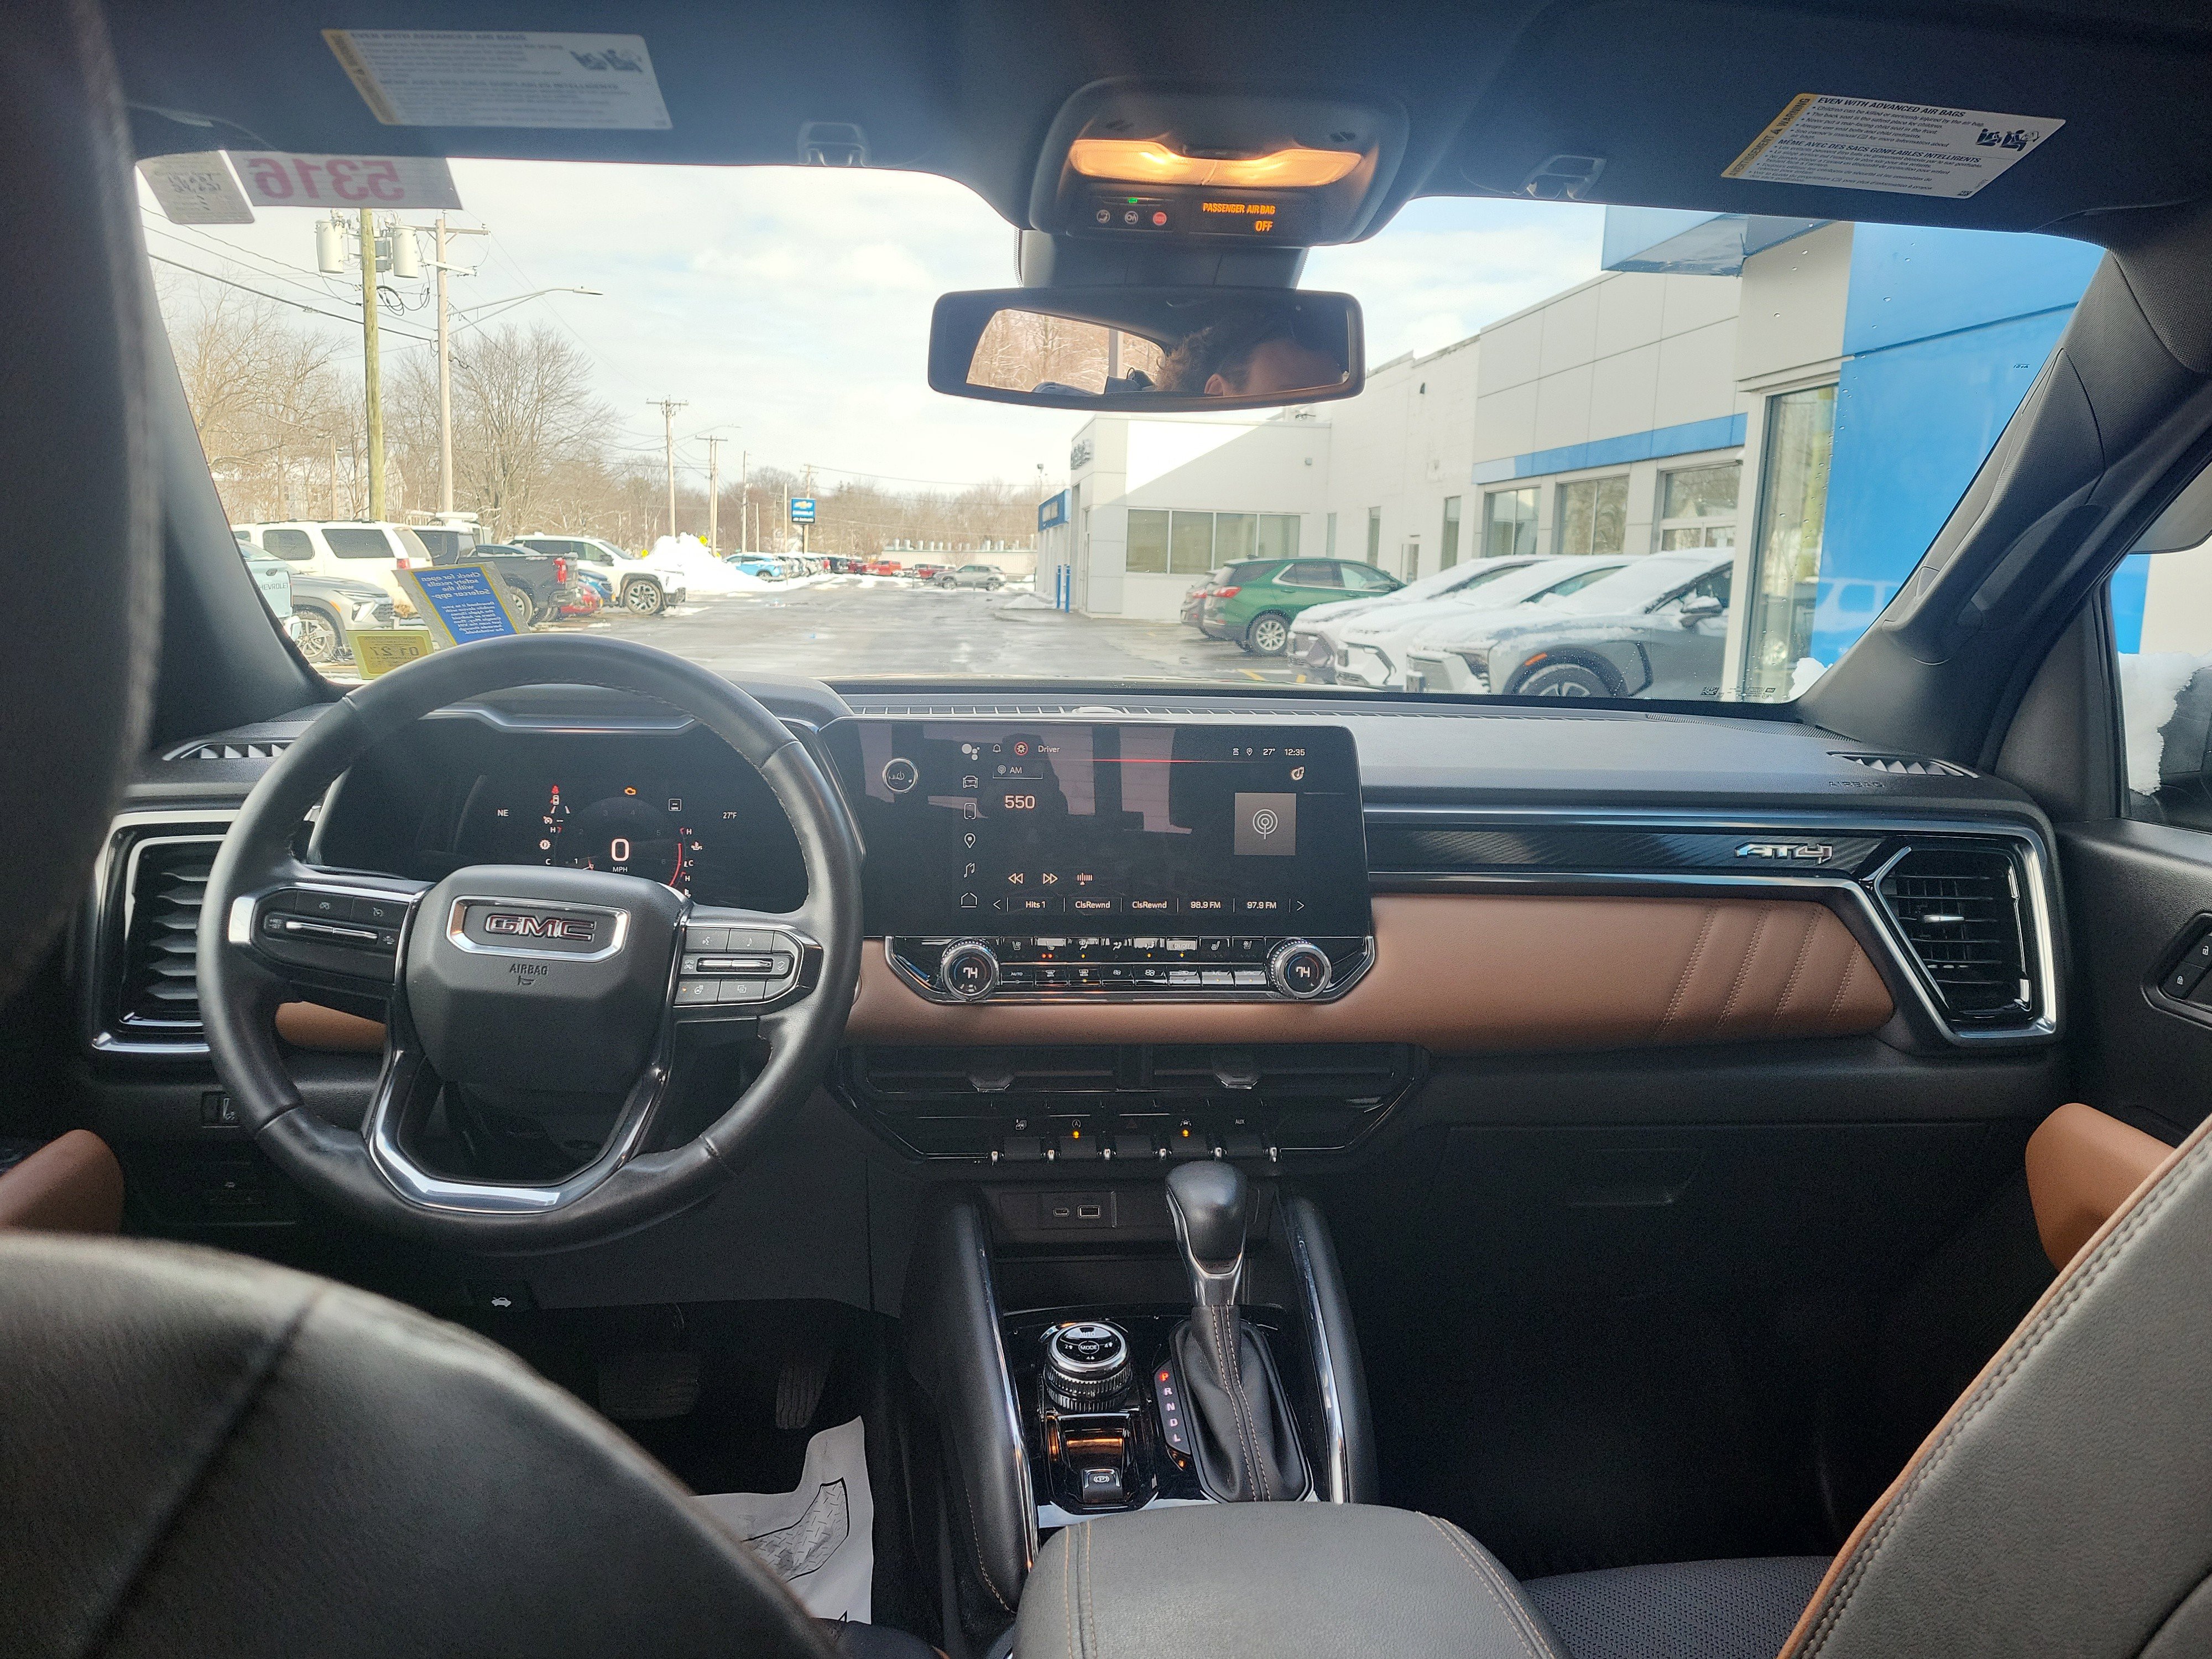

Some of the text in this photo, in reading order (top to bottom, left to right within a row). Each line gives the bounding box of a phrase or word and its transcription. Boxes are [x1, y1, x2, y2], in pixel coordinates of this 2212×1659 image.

[1779, 98, 1811, 127] WARNING
[1869, 102, 1921, 112] ADVANCED
[1871, 148, 1924, 157] GONFLABLES
[1923, 153, 1981, 163] INTELLIGENTS
[1202, 202, 1276, 215] PASSENGER AIR BAG
[1255, 220, 1274, 232] OFF
[1004, 795, 1036, 809] 550
[611, 838, 630, 862] 0
[1735, 842, 1833, 866] AT4
[486, 914, 596, 941] GMC
[508, 963, 549, 975] AIRBAG
[963, 967, 978, 979] 74
[1296, 966, 1311, 978] 74
[1161, 1373, 1168, 1381] P
[1164, 1387, 1172, 1396] R
[1166, 1402, 1175, 1411] N
[1170, 1418, 1178, 1427] D
[1173, 1433, 1181, 1442] L
